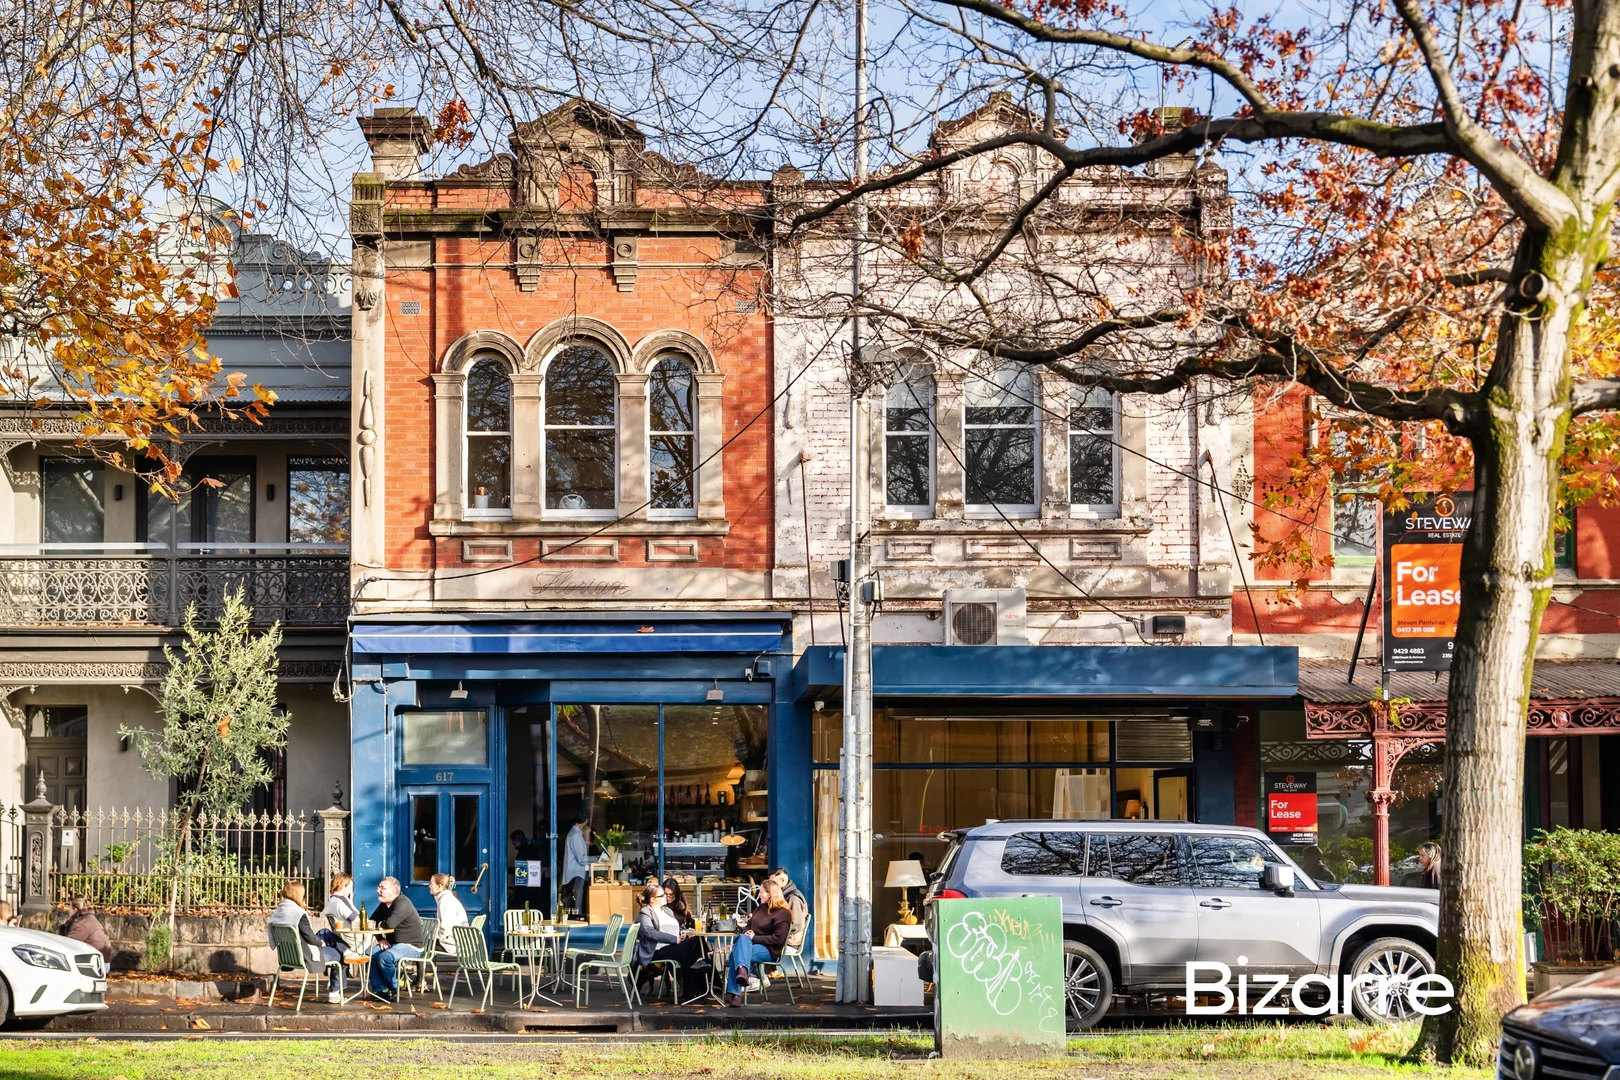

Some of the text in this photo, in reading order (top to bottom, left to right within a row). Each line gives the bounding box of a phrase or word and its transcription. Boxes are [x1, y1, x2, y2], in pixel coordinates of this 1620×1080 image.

[1396, 561, 1439, 582] For
[435, 772, 454, 782] 617
[1271, 800, 1288, 808] For
[1272, 810, 1302, 818] Lease
